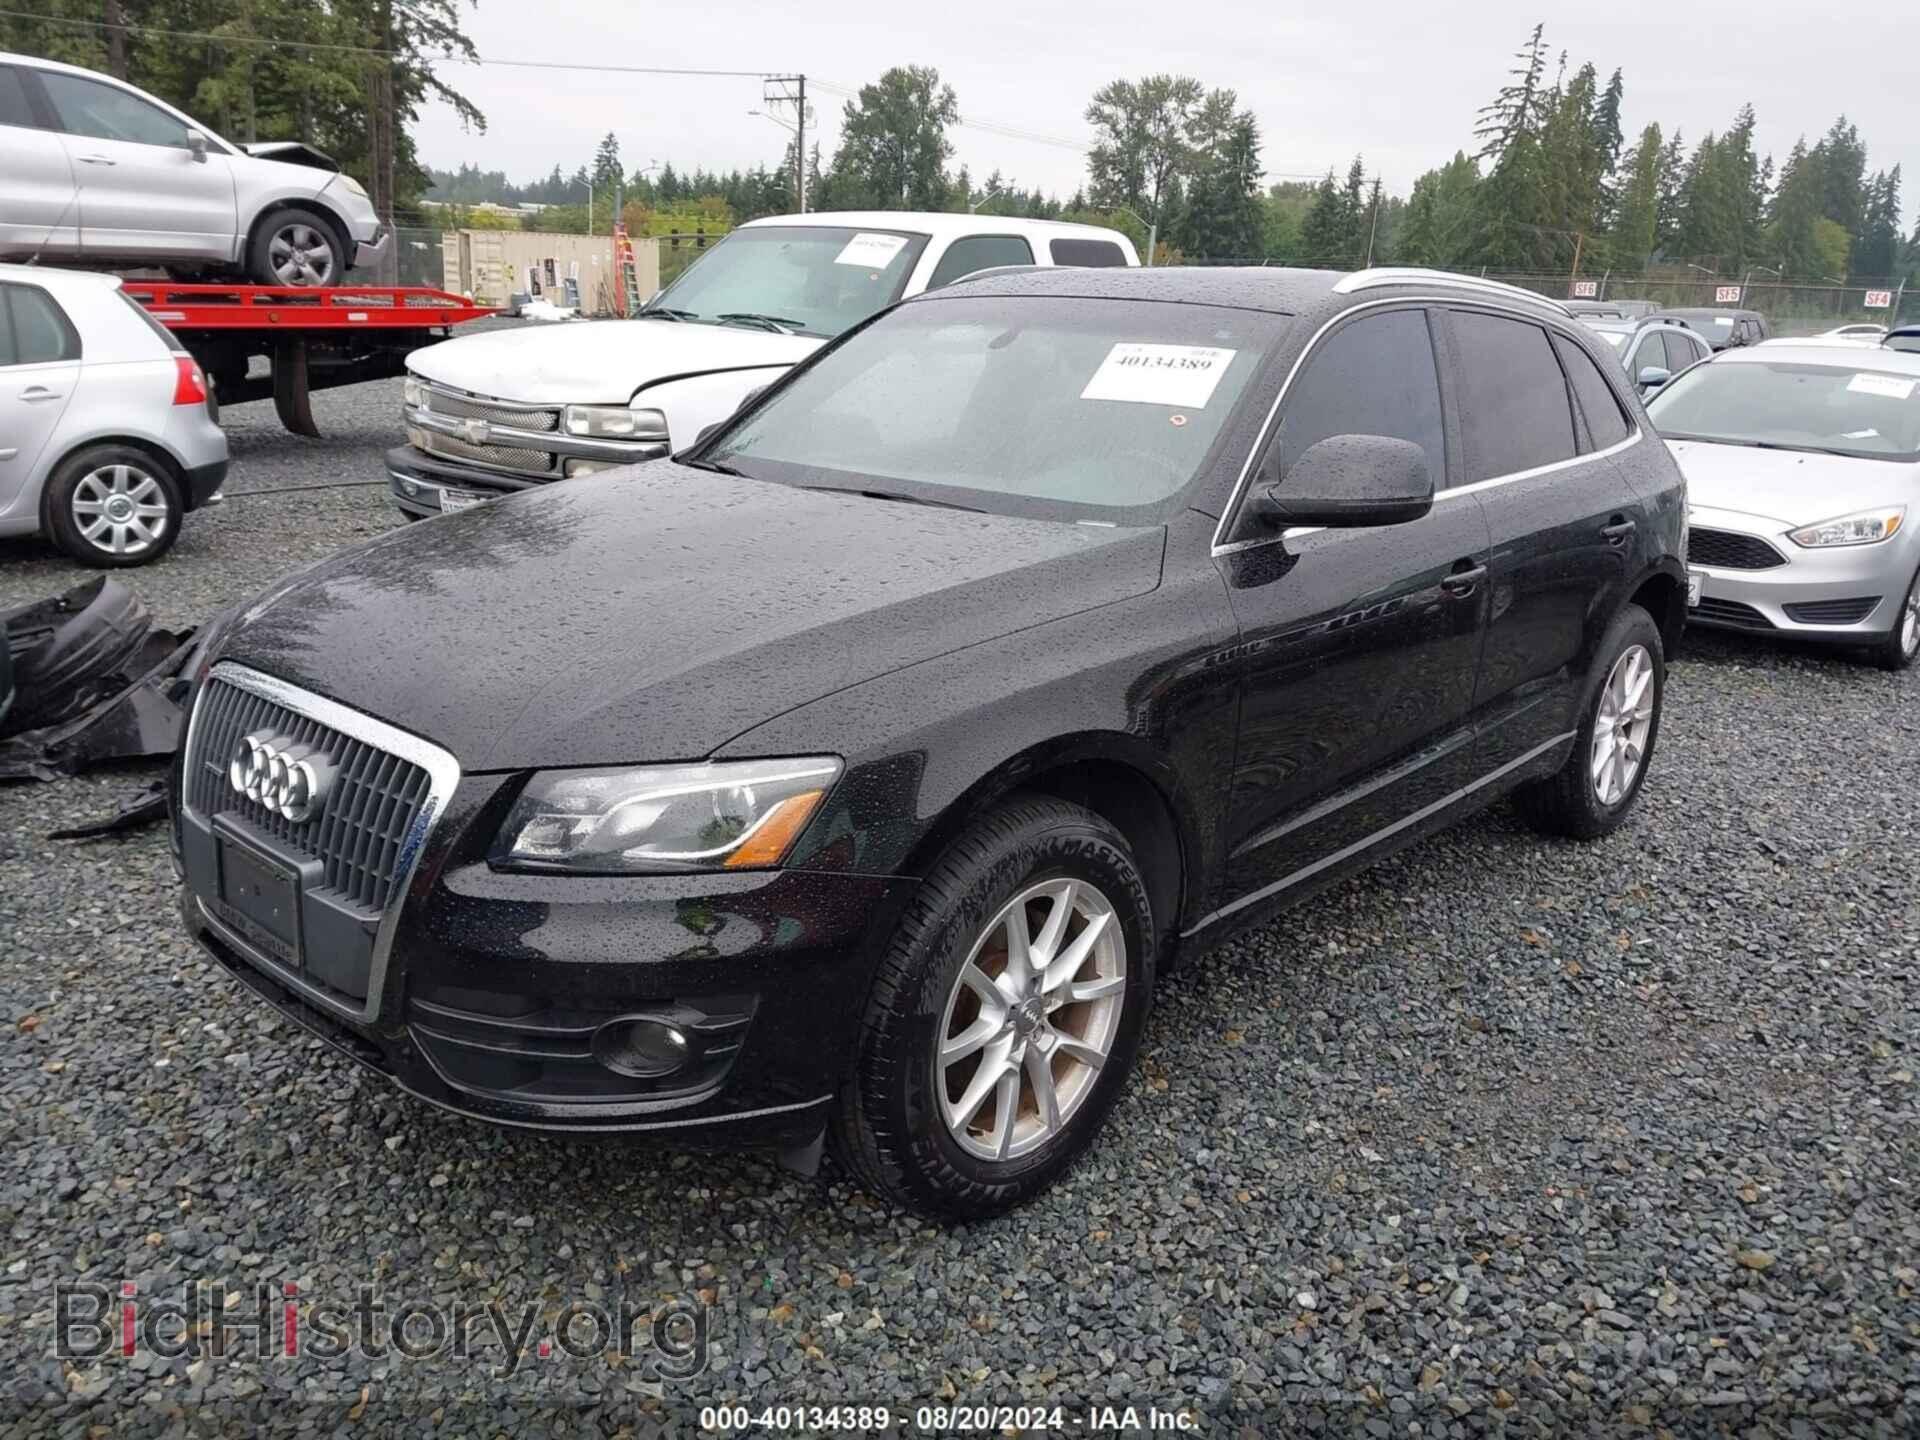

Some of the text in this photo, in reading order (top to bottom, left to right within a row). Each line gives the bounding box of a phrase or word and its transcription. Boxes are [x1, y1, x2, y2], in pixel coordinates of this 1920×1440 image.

[1576, 282, 1595, 295] SF6
[1718, 288, 1738, 301] SF5
[1867, 292, 1889, 305] SF4
[1115, 355, 1213, 370] 40134389
